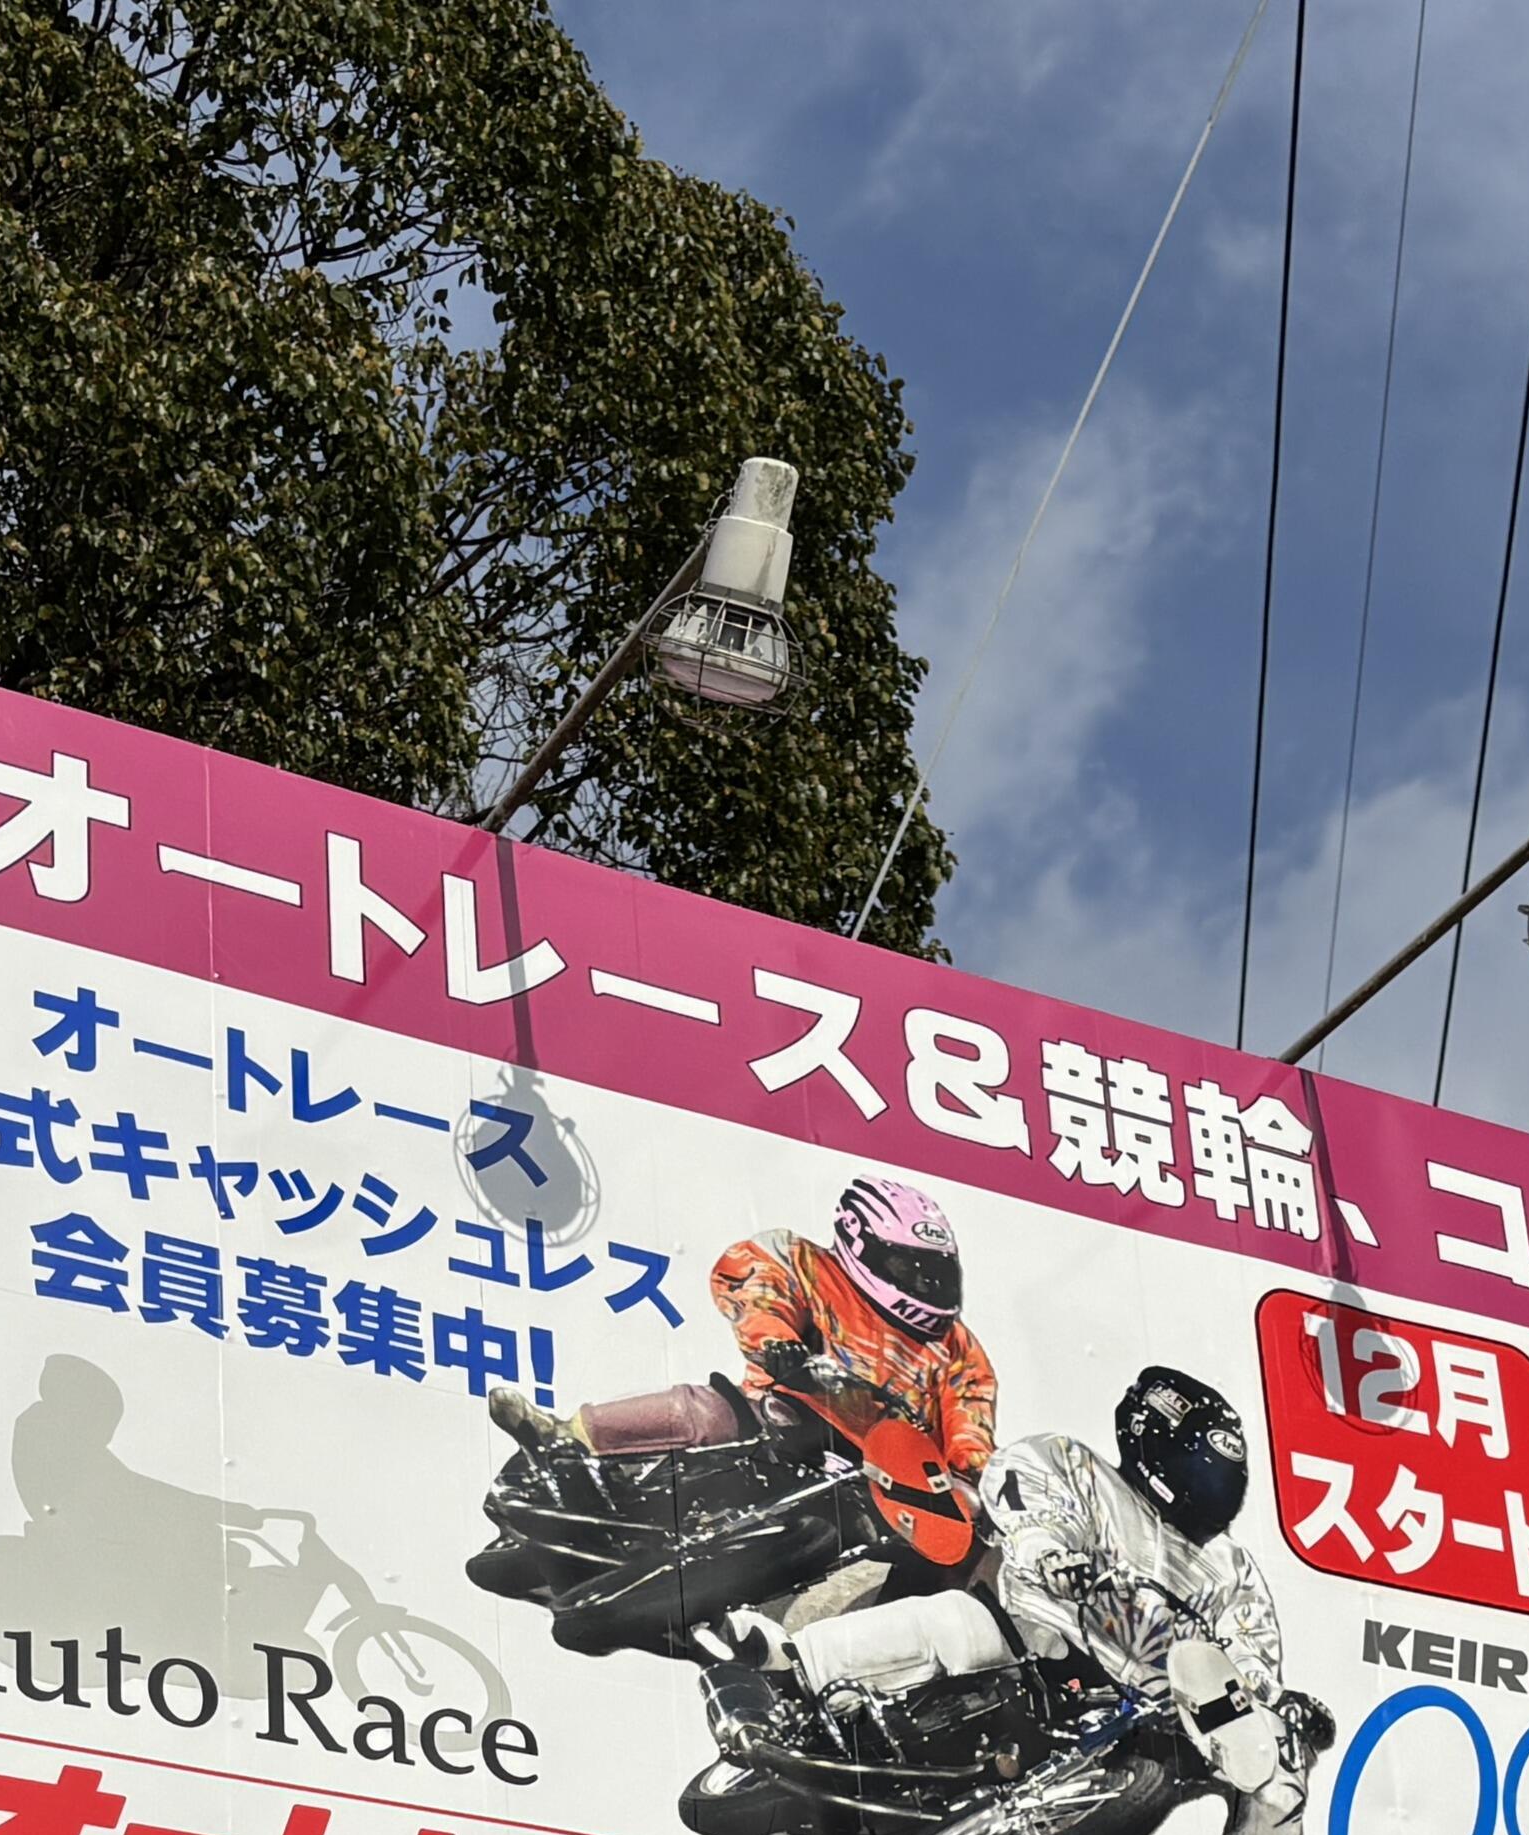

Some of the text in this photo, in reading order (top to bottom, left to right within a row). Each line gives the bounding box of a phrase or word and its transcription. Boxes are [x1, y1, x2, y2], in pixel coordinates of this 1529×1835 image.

[31, 987, 548, 1187] オートレース
[30, 1213, 556, 1408] 会員募集中!
[1304, 1312, 1512, 1459] 12月
[253, 1642, 540, 1786] Race
